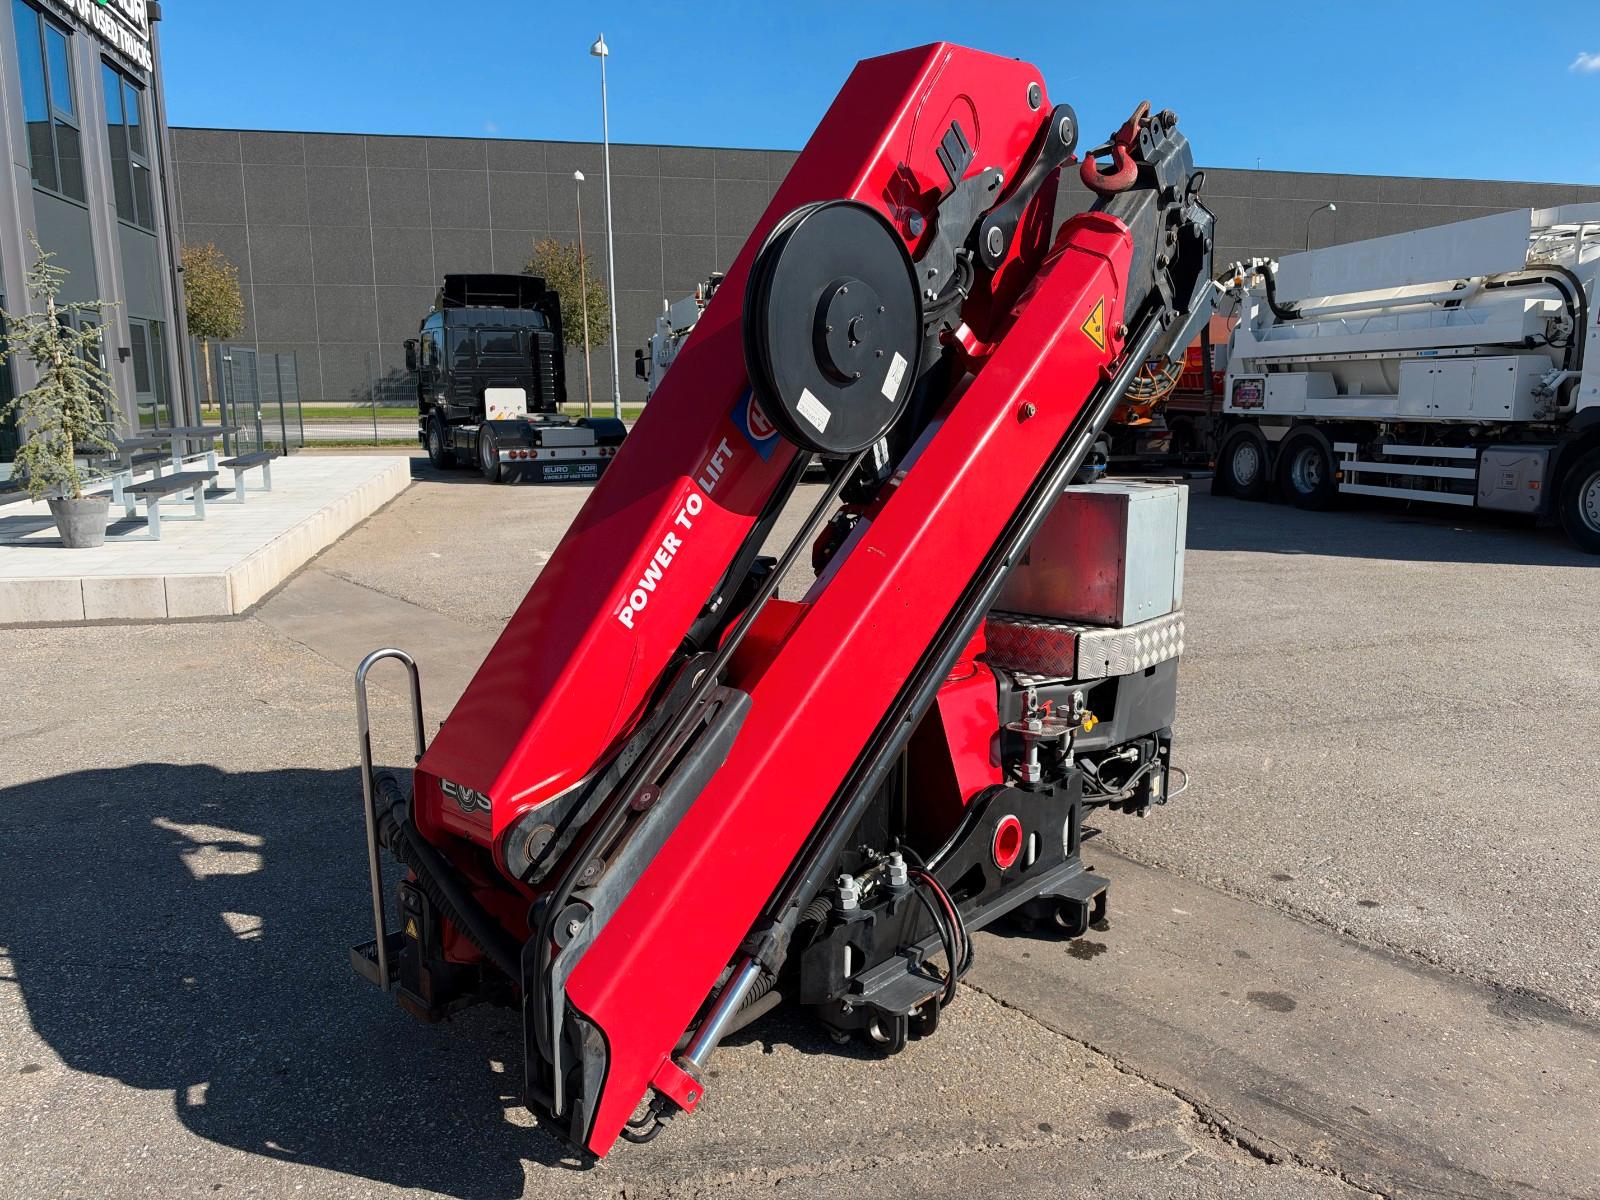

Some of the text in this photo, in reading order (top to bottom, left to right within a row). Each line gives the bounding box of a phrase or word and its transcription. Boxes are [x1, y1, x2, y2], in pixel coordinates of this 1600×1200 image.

[91, 1, 118, 43] USED
[117, 23, 153, 72] TRUCKS
[618, 437, 734, 630] POWER TO LIFT
